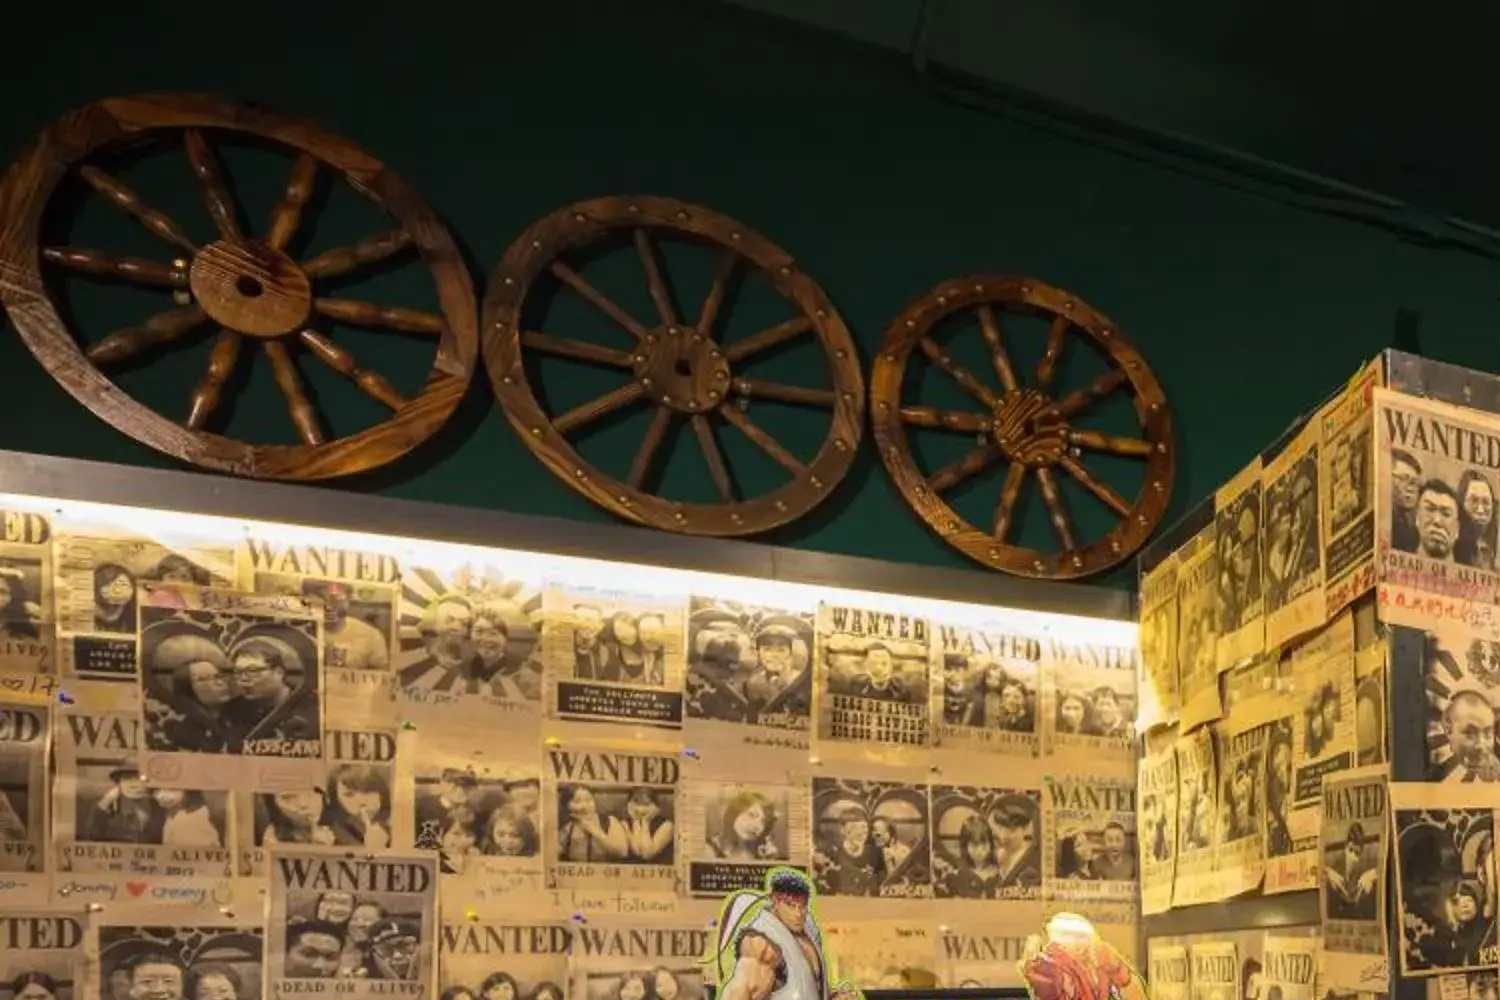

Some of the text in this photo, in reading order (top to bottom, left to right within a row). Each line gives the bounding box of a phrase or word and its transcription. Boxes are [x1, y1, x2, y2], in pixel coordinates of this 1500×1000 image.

[246, 538, 399, 584] WANTED
[1389, 556, 1422, 571] DEAD
[1431, 563, 1446, 577] OR
[833, 608, 924, 641] WANTED
[941, 625, 1040, 661] WANTED
[550, 751, 680, 785] WANTED
[73, 846, 122, 858] DEAD
[138, 849, 155, 859] OR
[279, 857, 429, 893] WANTED
[558, 867, 594, 877] DEAD
[440, 926, 569, 954] WANTED
[580, 927, 707, 957] WANTED
[282, 982, 327, 993] DEAD
[336, 982, 355, 993] OR
